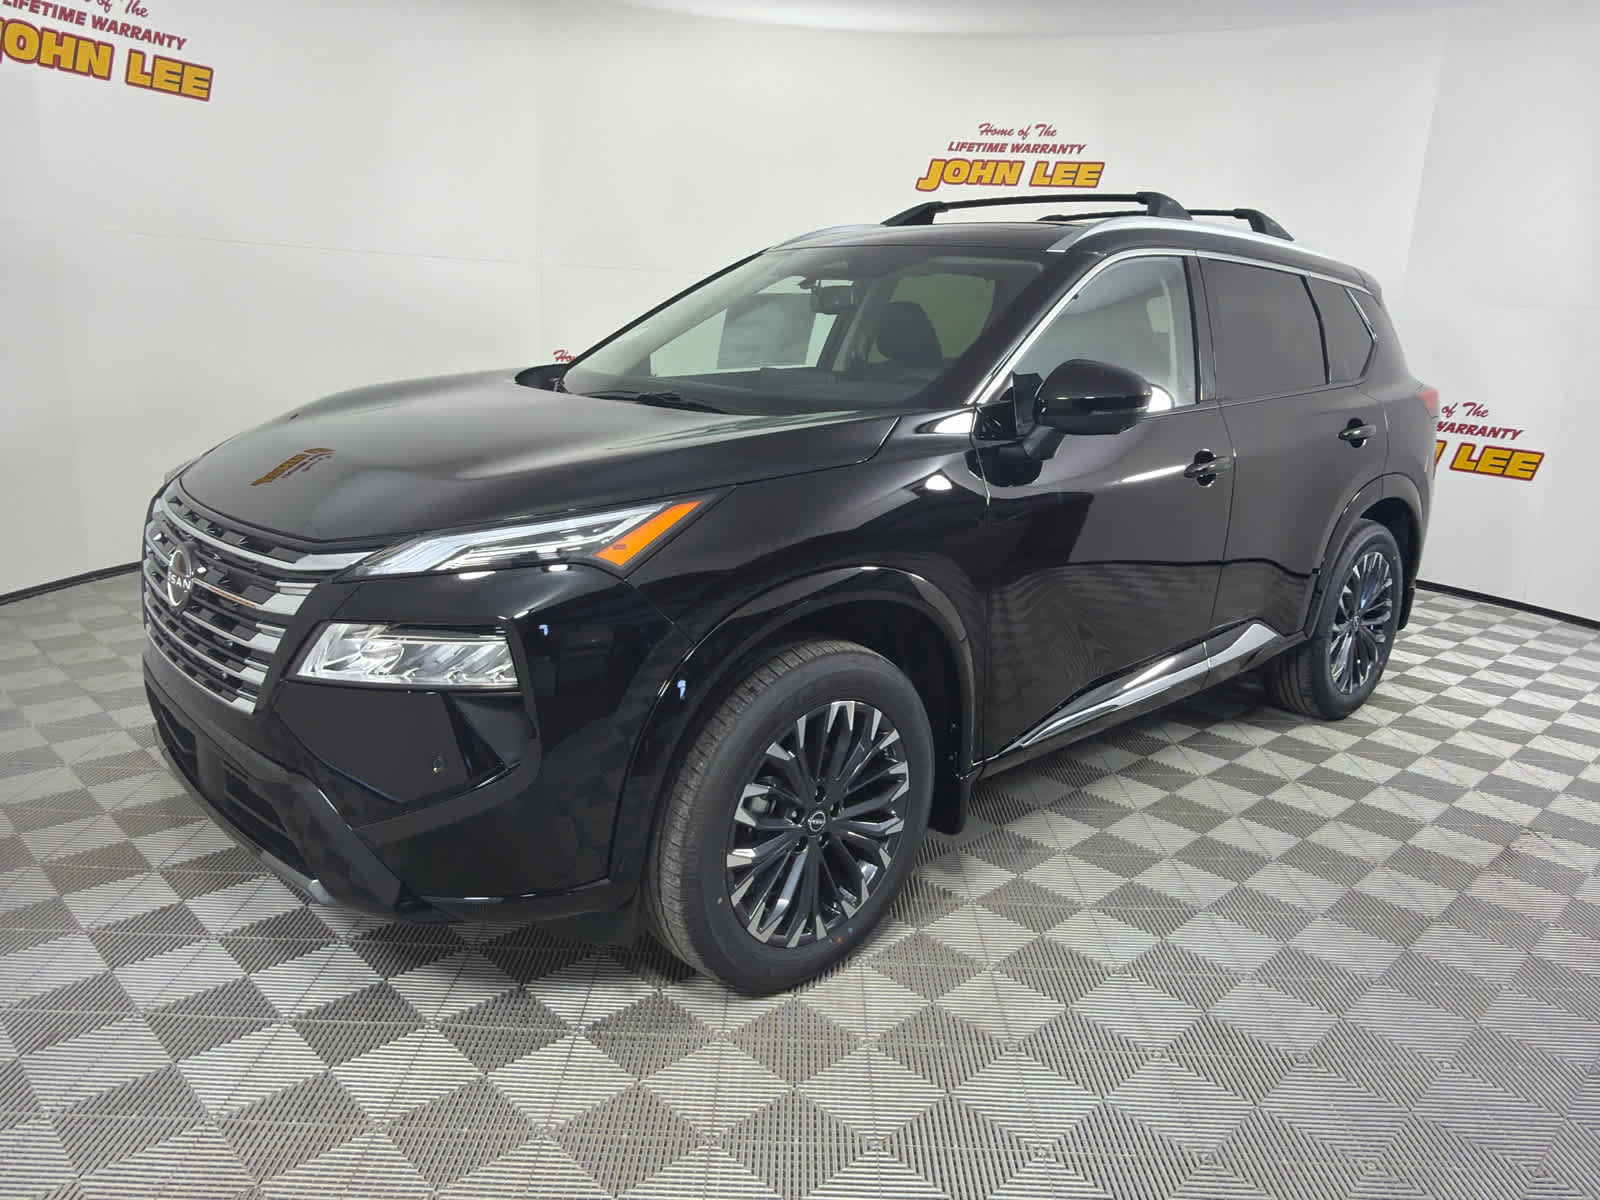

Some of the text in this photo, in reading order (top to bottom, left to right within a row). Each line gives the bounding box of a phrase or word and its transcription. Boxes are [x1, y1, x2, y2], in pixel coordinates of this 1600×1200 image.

[120, 0, 149, 18] The
[91, 15, 188, 50] WARRANTY
[0, 16, 214, 102] OHN LEE
[978, 123, 1058, 140] Home of The
[948, 141, 1087, 154] LIFETIME WARRANTY
[915, 158, 1105, 192] JOHN LEE
[1441, 401, 1489, 418] of The
[1449, 442, 1545, 481] LEE
